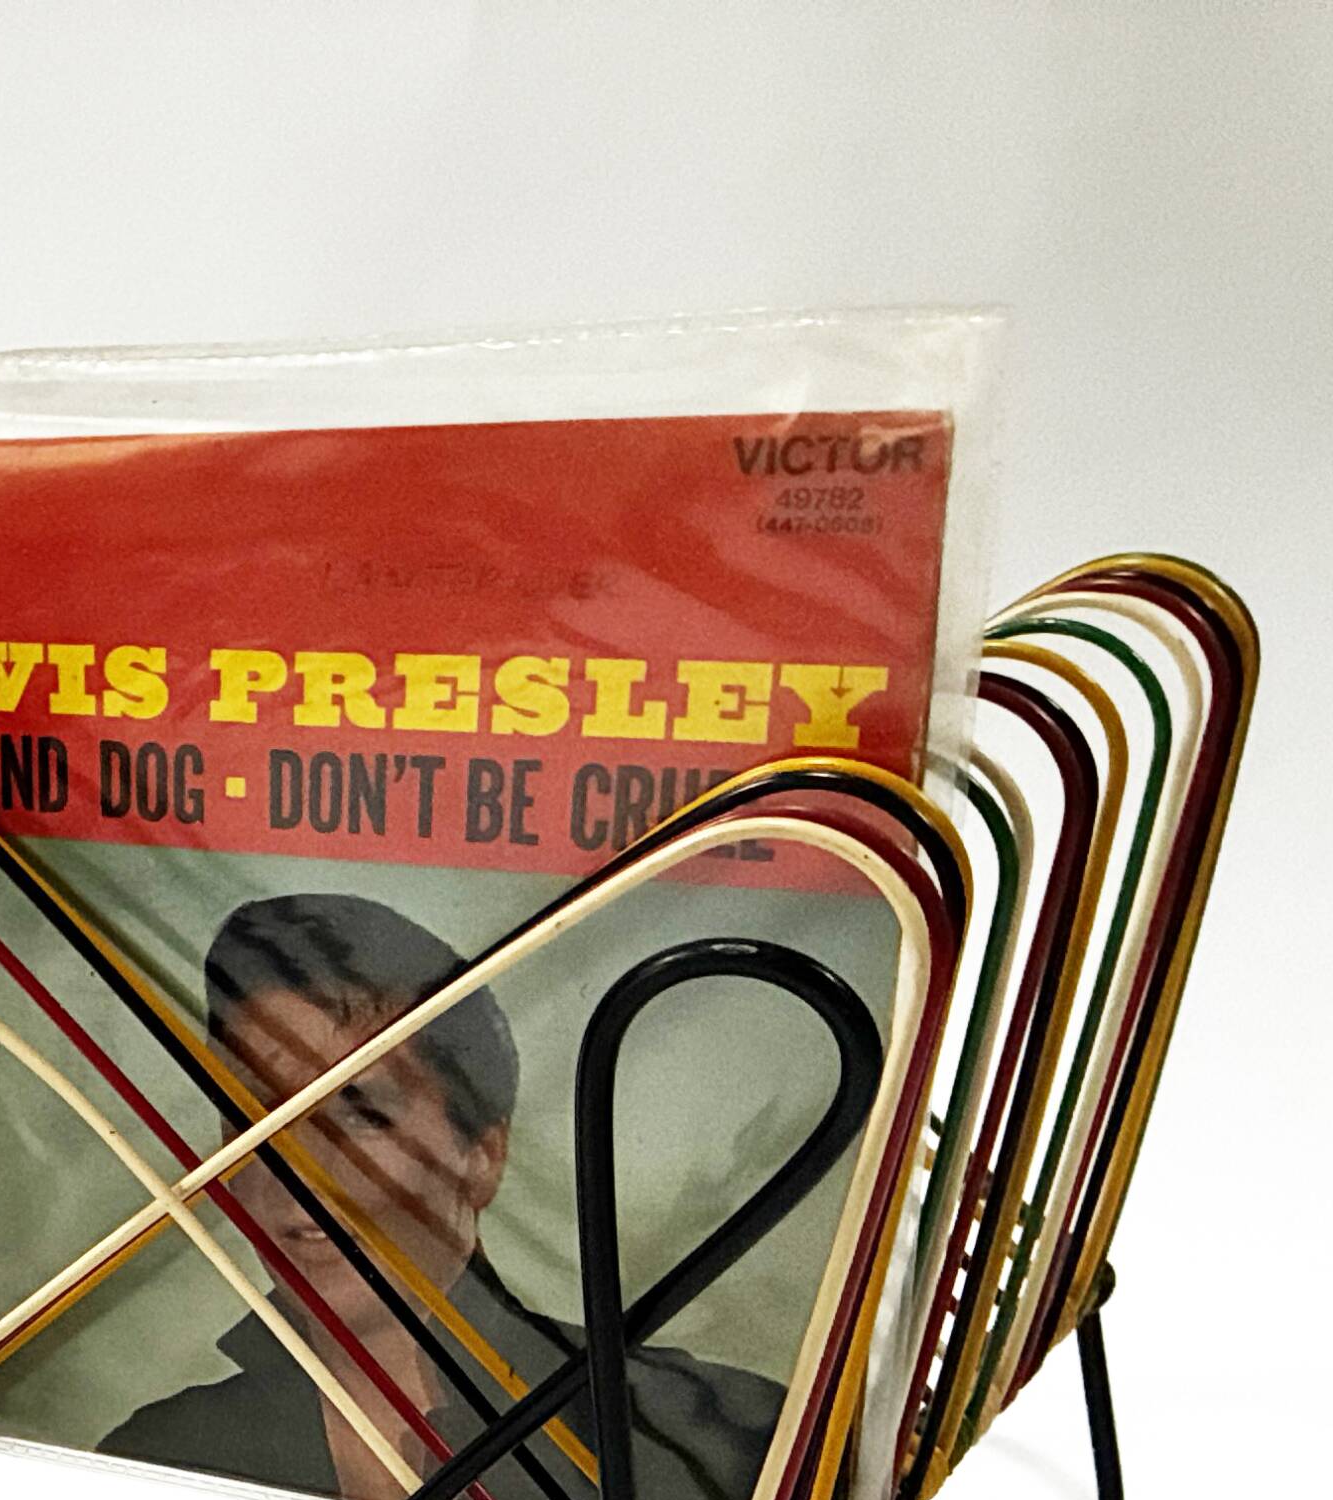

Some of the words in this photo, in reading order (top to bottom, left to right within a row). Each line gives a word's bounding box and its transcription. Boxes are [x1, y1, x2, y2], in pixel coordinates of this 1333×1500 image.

[734, 435, 924, 476] VICTOR
[774, 486, 866, 512] 49782
[208, 647, 889, 749] PRESLEY
[99, 739, 205, 825] DOG
[268, 747, 446, 840] DON'T
[464, 757, 543, 847] BE
